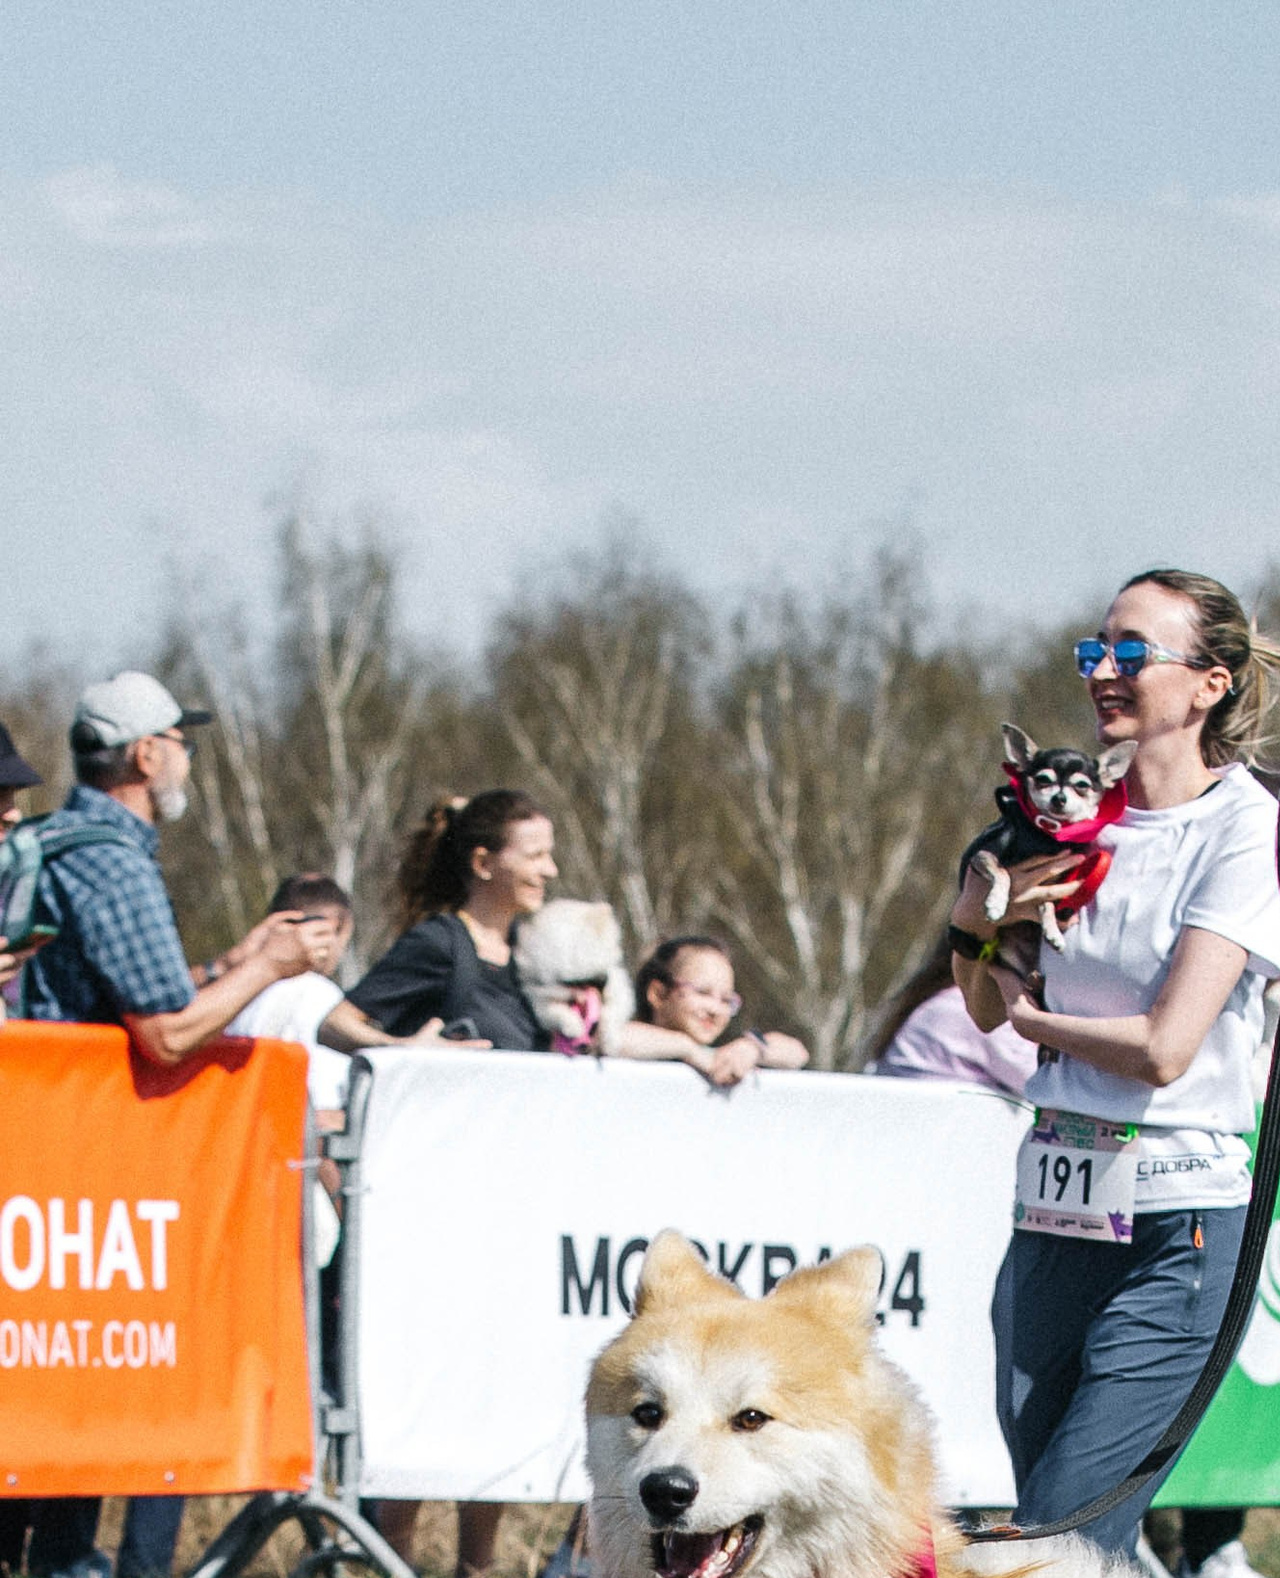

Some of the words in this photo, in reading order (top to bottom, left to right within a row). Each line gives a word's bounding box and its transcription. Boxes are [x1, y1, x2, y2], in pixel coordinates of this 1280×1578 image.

[1038, 1154, 1093, 1205] 191
[1152, 1158, 1212, 1175] ДОБРА
[0, 1194, 180, 1291] ОНАТ
[0, 1319, 177, 1368] ONAT.COM
